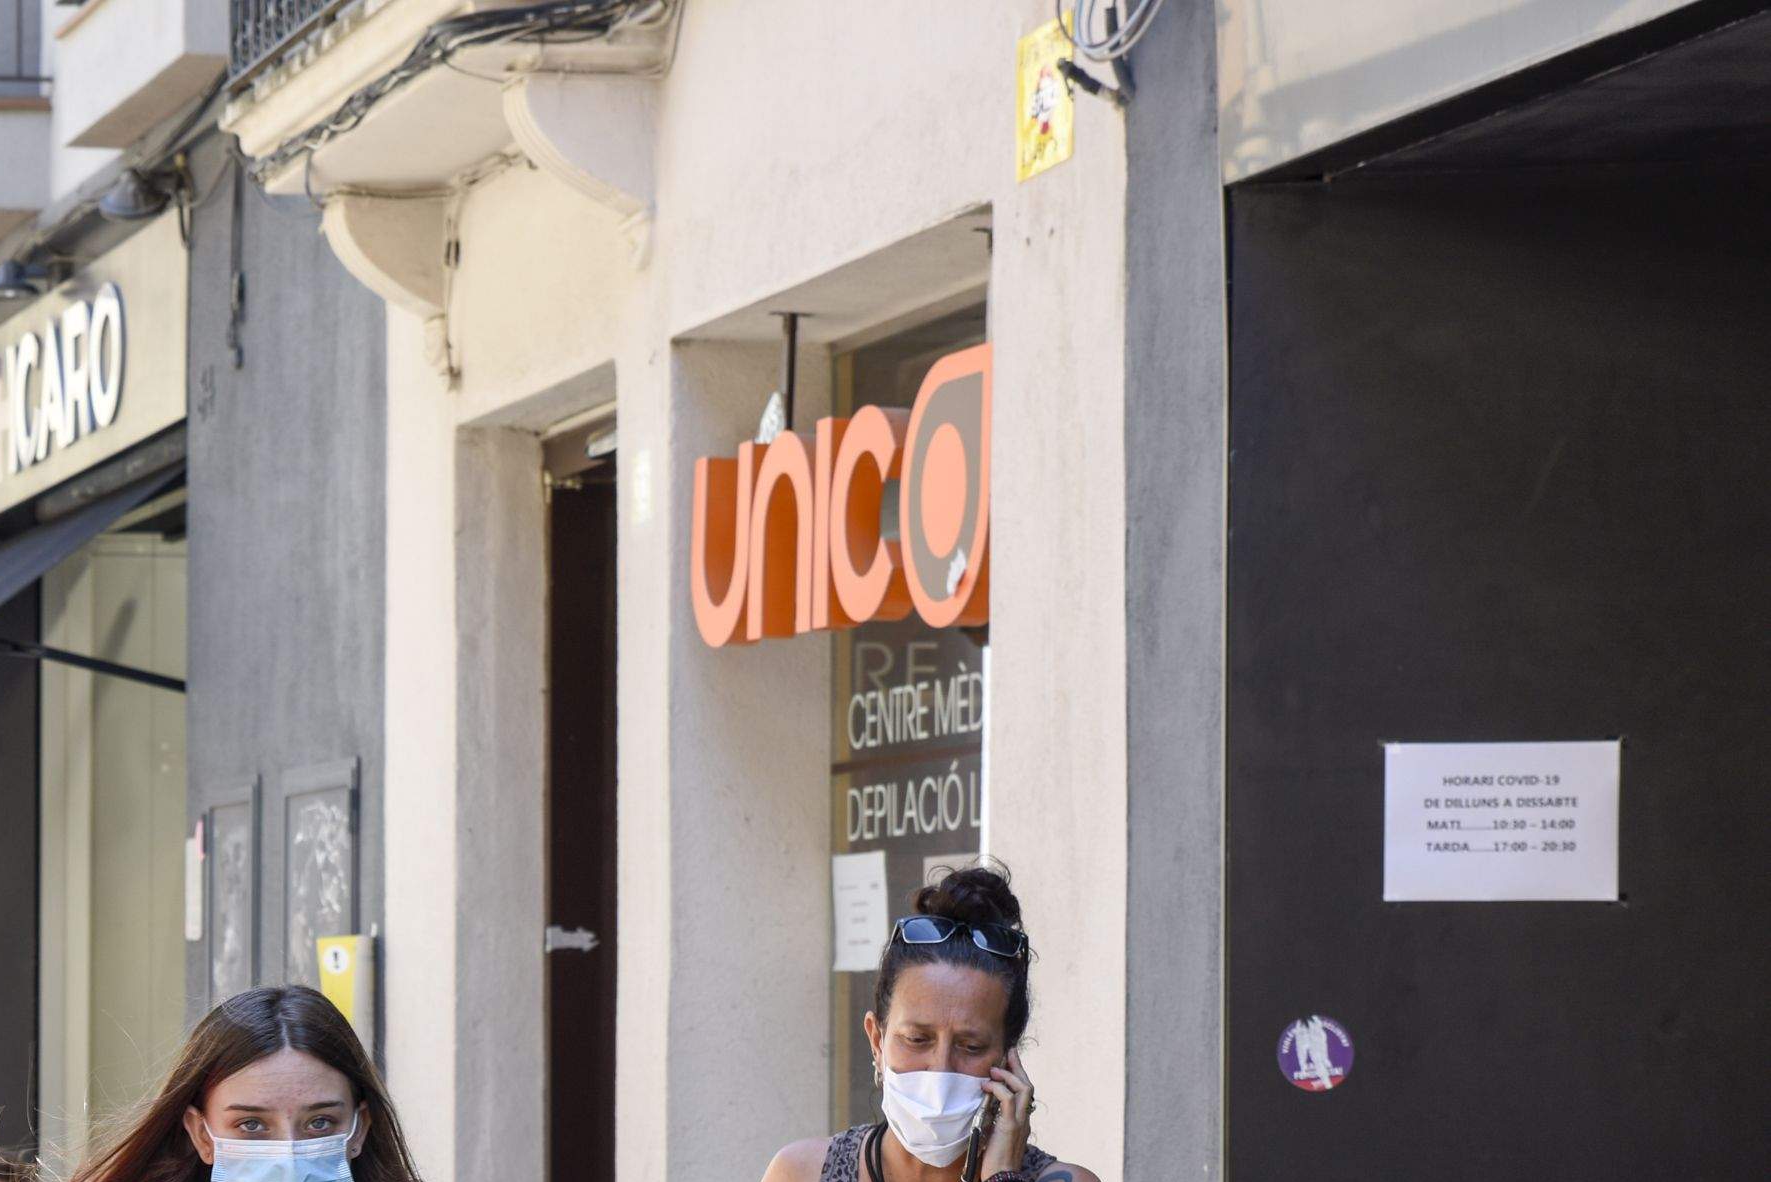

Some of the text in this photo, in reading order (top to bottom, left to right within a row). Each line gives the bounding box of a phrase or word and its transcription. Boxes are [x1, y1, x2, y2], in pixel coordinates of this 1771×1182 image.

[848, 681, 929, 750] CENTRE
[1442, 775, 1494, 786] HORARI
[848, 758, 964, 842] DEPILACIÓ
[1423, 797, 1579, 809] DE DILLUNS A DISSABTE
[1541, 819, 1576, 830] 14:00
[1541, 841, 1577, 852] 20:30
